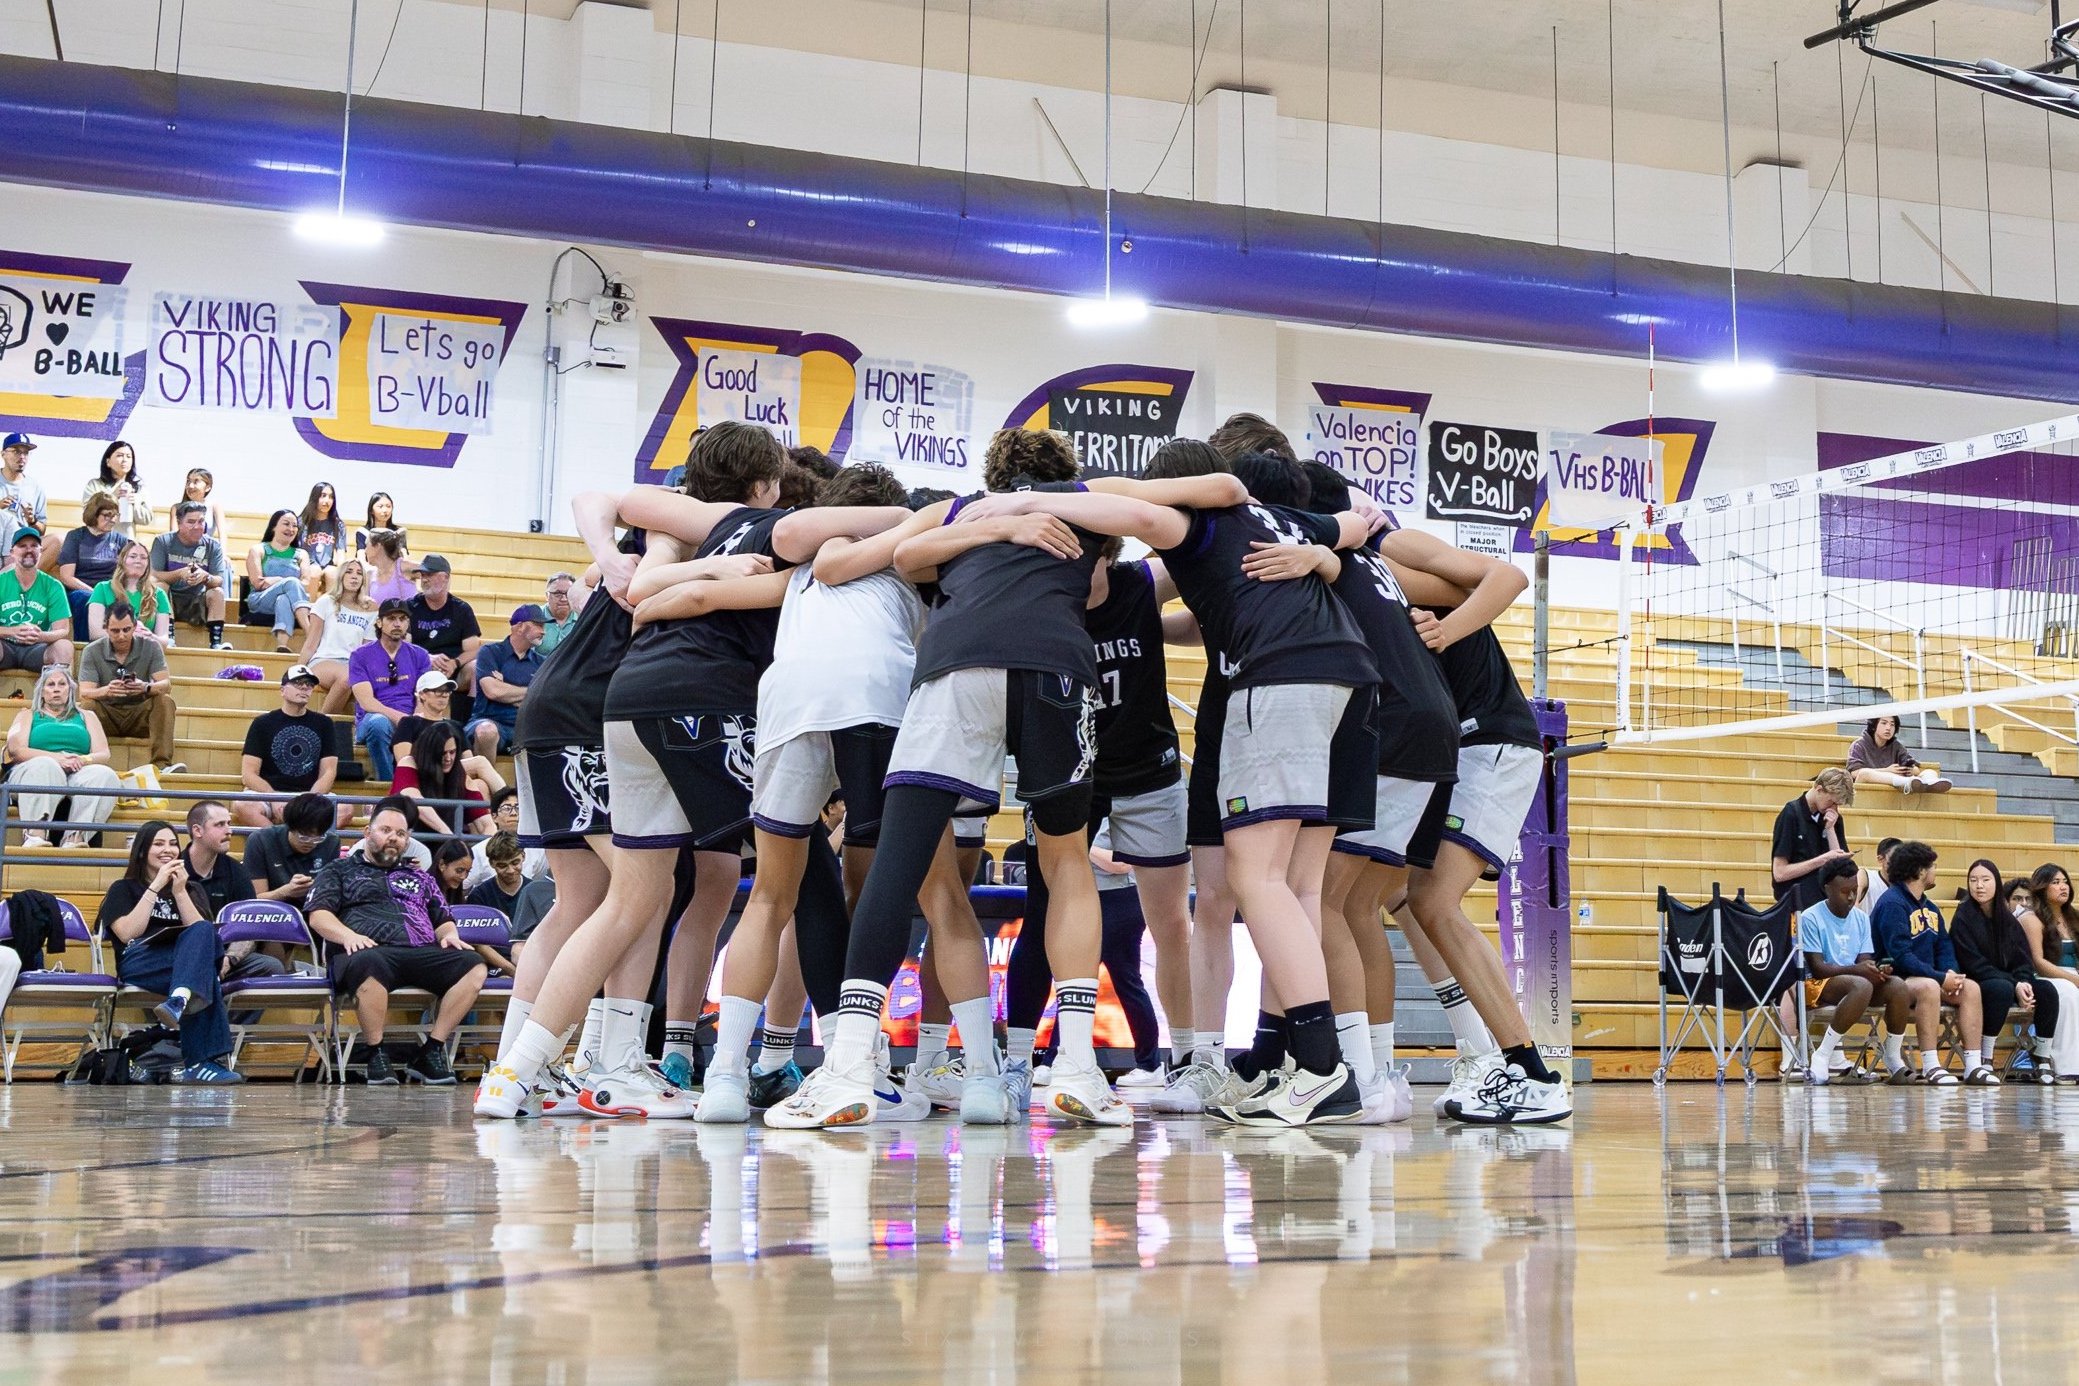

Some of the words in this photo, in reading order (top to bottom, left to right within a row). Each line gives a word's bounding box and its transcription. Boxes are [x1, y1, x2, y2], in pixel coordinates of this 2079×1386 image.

[42, 290, 96, 317] WE
[163, 300, 276, 333] VIKING
[381, 315, 453, 360] Lets
[463, 341, 495, 369] go
[34, 349, 122, 376] B-BALL
[159, 330, 331, 410] STRONG
[705, 355, 758, 393] Good
[378, 375, 488, 419] B-Vball
[865, 368, 936, 406] HOME
[744, 395, 789, 425] Luck
[908, 407, 935, 431] the
[1063, 397, 1161, 420] VIKING
[1316, 412, 1417, 446] Valencia
[895, 431, 967, 468] VIKINGS
[1315, 450, 1344, 468] on
[1344, 446, 1417, 479] TOP!
[1441, 426, 1477, 465] Go
[1483, 430, 1538, 480] Boys
[1436, 471, 1515, 511] V-Ball
[1470, 537, 1497, 546] MAJOR
[1094, 638, 1142, 662] INGS
[230, 913, 294, 924] VALENCIA
[456, 917, 500, 928] LENCIA
[1510, 838, 1526, 1015] ALENCI
[1549, 929, 1559, 967] sports
[1677, 936, 1704, 953] aden
[839, 996, 880, 1009] LUNKS
[1063, 994, 1096, 1005] SLUN
[1549, 973, 1560, 1025] imports
[1539, 1045, 1572, 1058] VALENCIA
